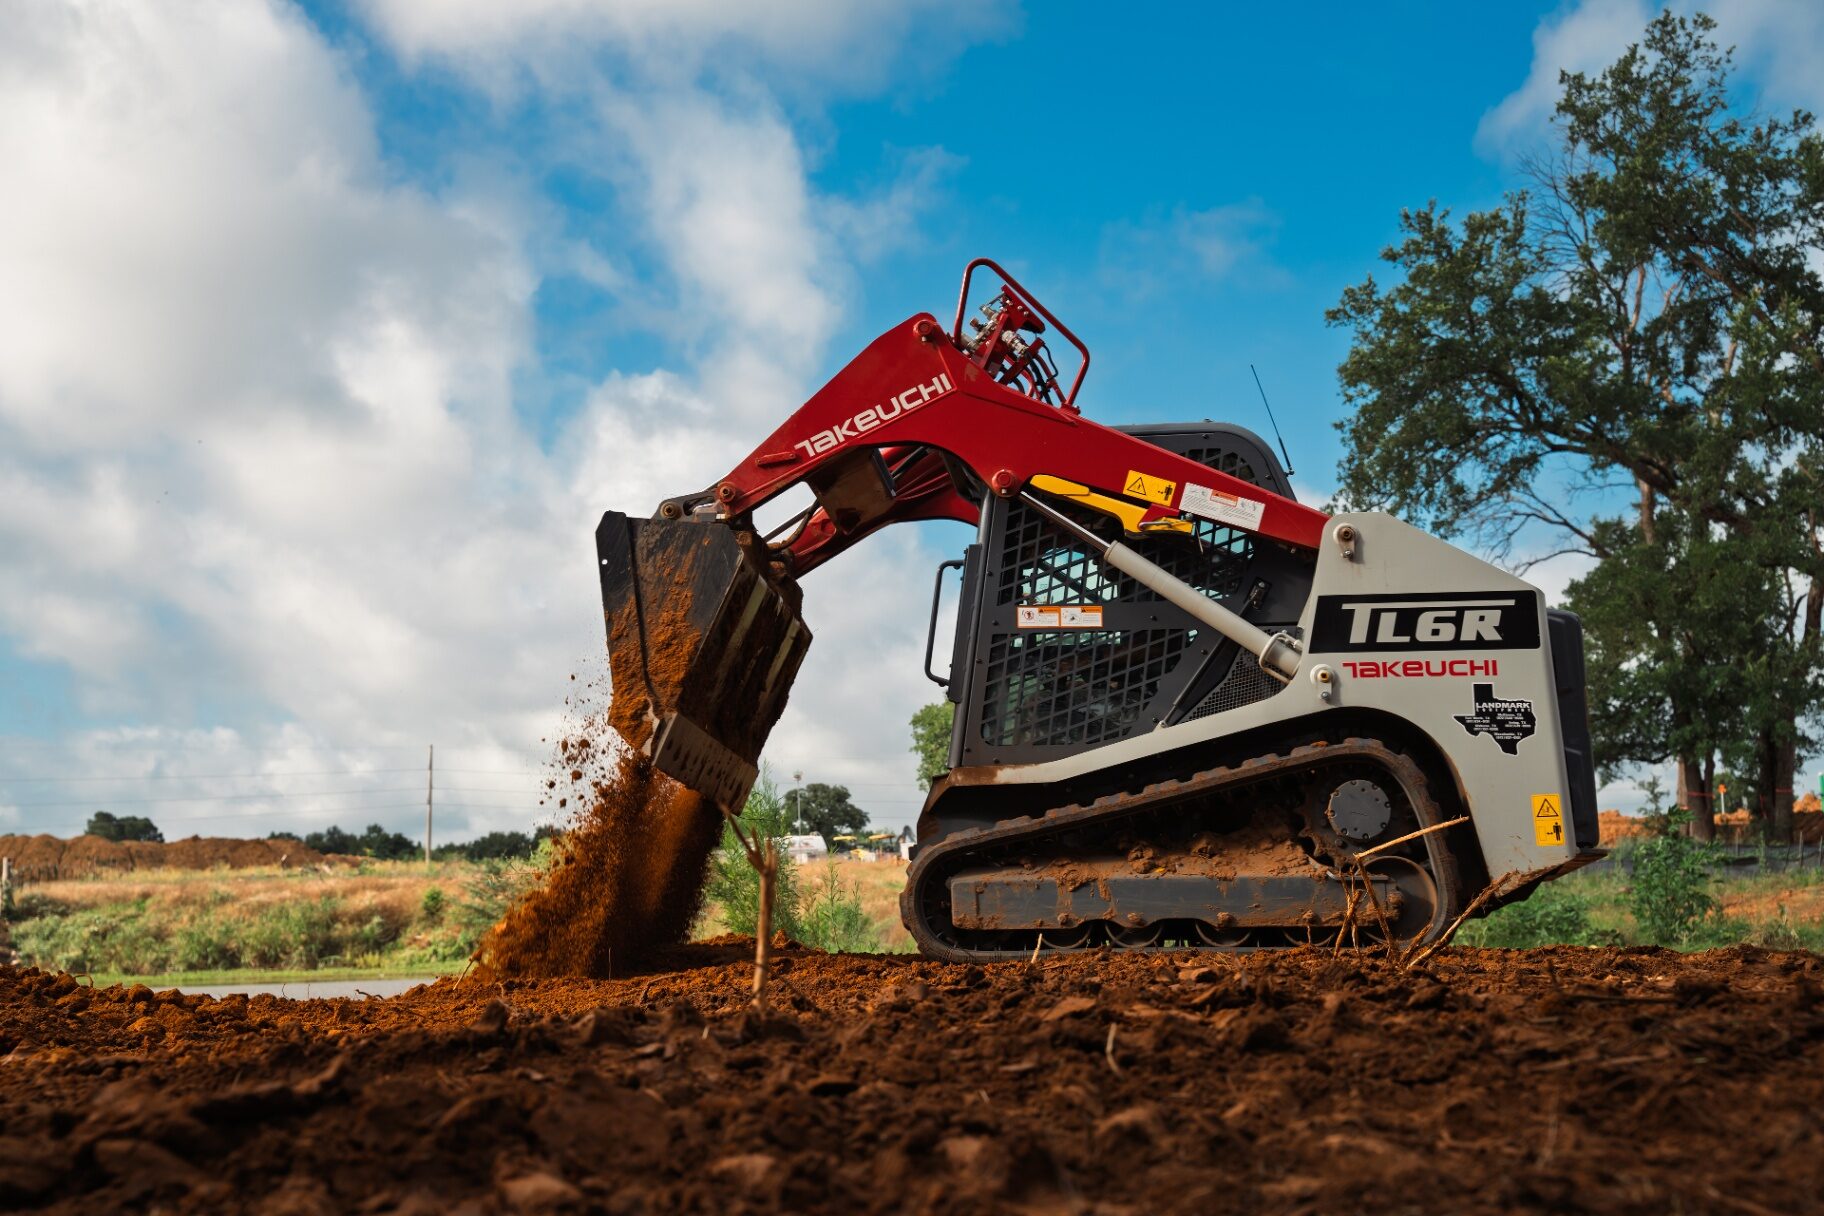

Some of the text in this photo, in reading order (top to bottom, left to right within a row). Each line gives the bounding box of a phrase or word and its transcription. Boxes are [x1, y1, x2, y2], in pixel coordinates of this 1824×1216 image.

[794, 373, 953, 457] TAKEUCHI
[1341, 599, 1516, 644] TL6R
[1342, 660, 1498, 678] TAKEUCHI
